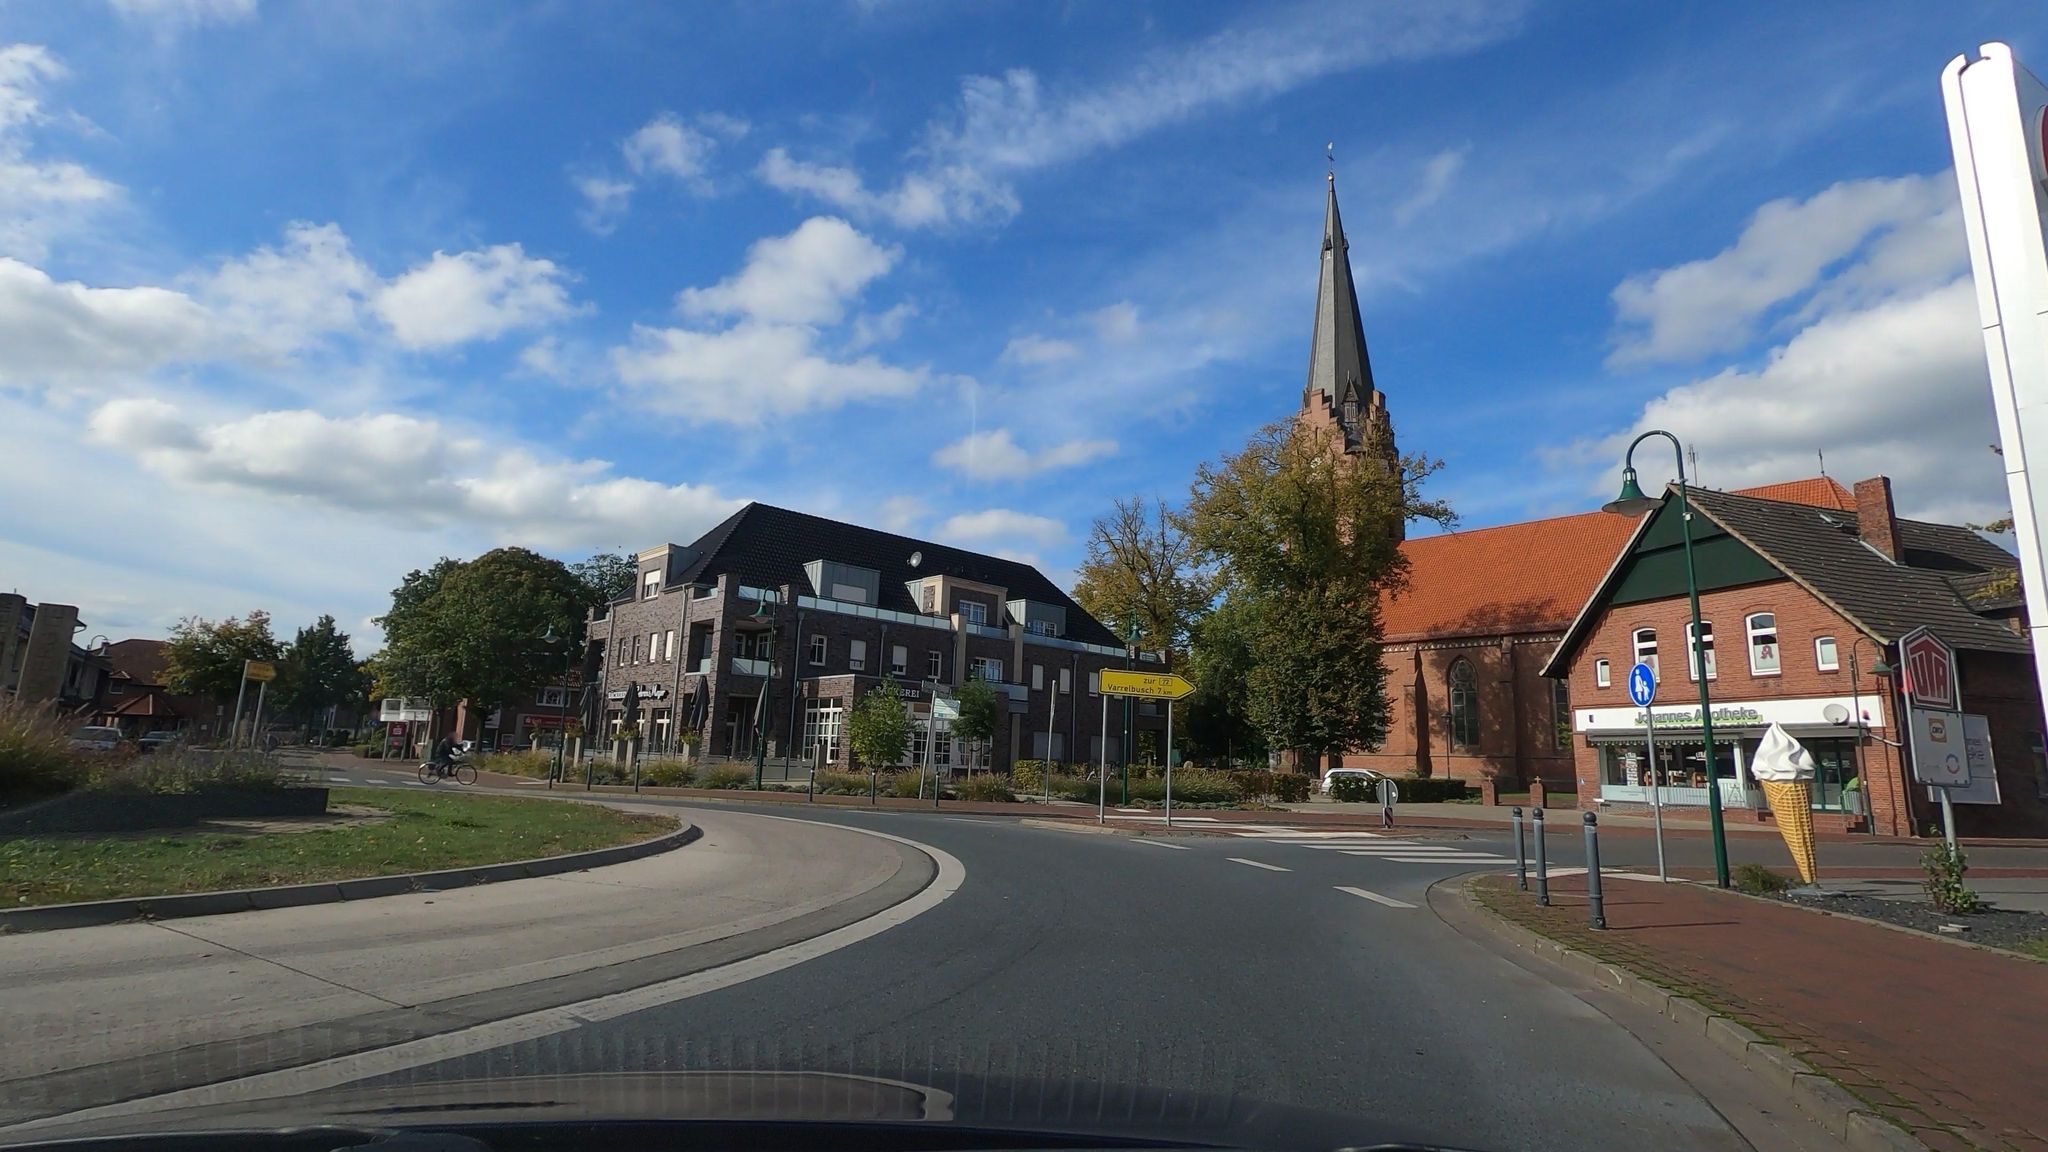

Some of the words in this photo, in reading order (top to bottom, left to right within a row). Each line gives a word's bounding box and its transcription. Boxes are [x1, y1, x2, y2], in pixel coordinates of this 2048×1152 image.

[1911, 650, 1948, 701] UTA
[875, 685, 920, 698] BKEREI
[1107, 683, 1154, 694] Varrelbusch
[1694, 706, 1758, 721] Aotheke
